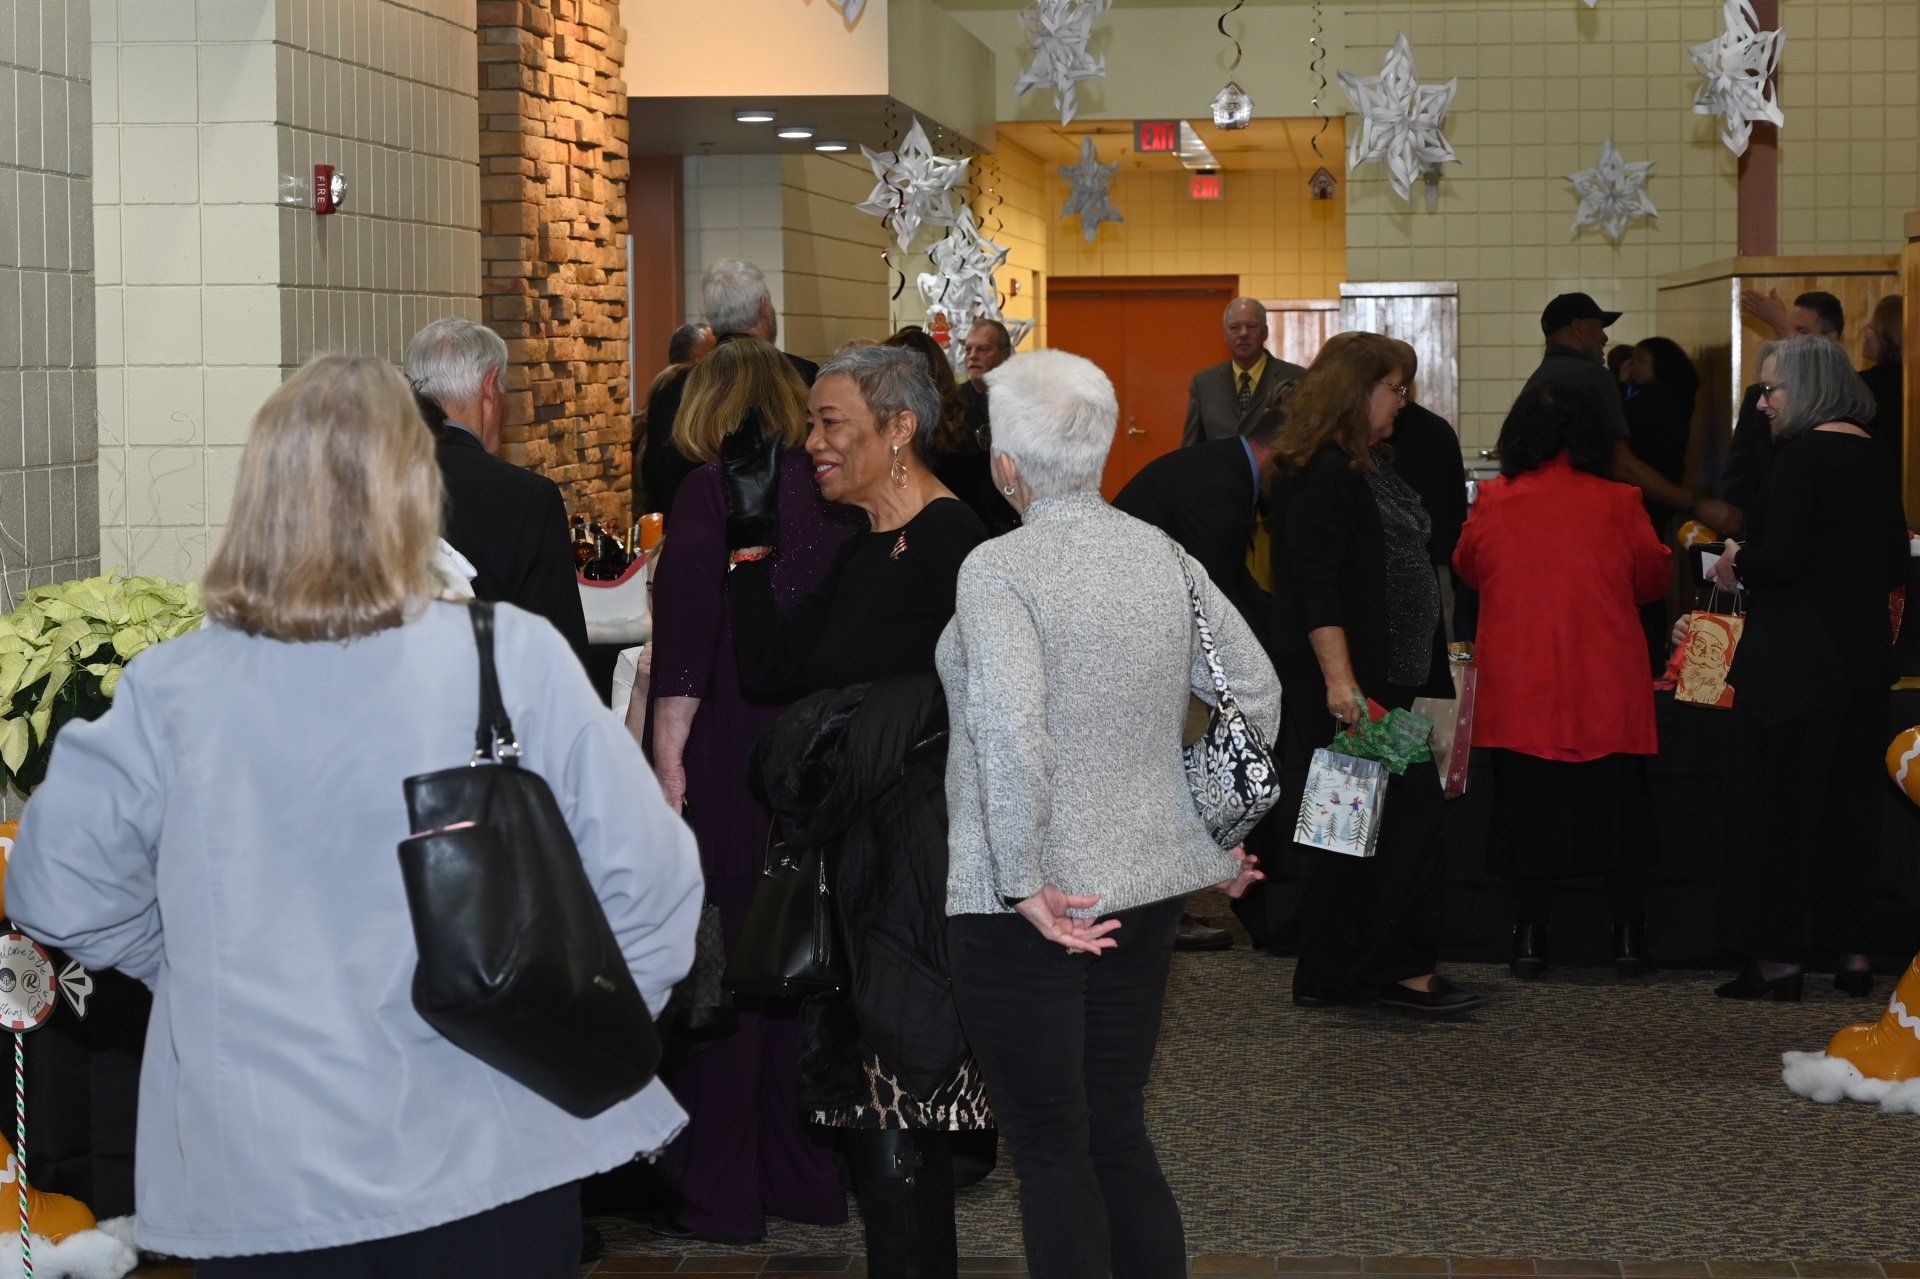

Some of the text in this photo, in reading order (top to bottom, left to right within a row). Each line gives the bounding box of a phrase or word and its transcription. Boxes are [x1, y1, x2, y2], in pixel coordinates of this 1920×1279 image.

[1142, 123, 1176, 151] EXIT
[317, 175, 326, 203] FIRE
[1193, 176, 1219, 199] EXIT
[1695, 677, 1717, 693] Jolly
[0, 944, 26, 959] elcome
